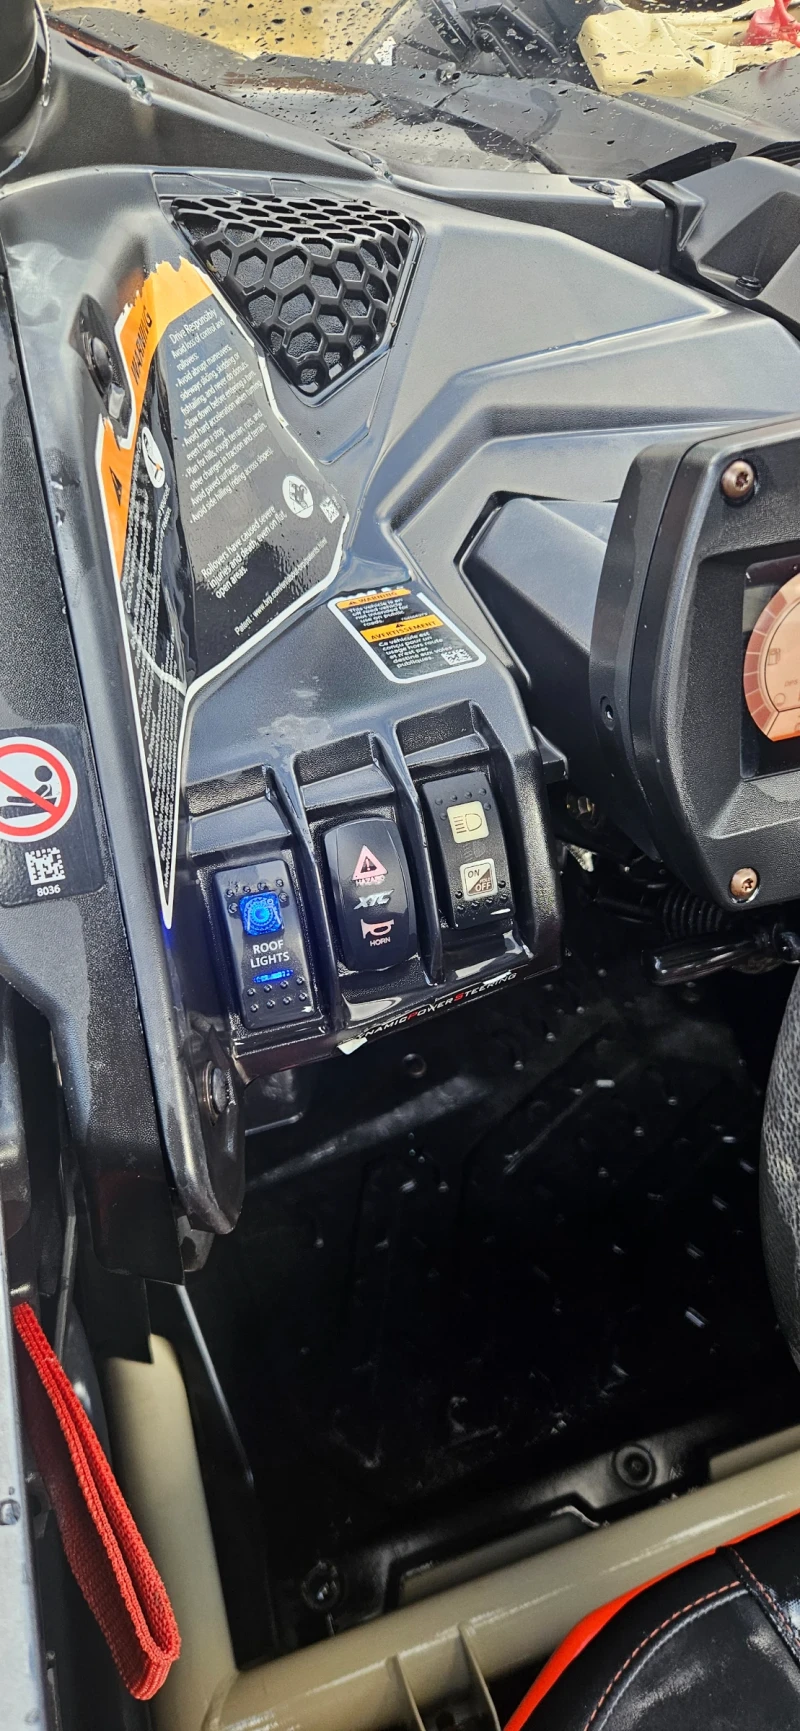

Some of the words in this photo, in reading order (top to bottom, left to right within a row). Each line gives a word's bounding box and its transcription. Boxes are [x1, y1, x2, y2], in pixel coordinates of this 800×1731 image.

[169, 329, 188, 344] Drive
[183, 308, 218, 334] Responsibly
[131, 305, 153, 386] WARNING
[171, 342, 188, 359] Avoid
[184, 338, 197, 350] loss
[195, 332, 201, 344] of
[200, 323, 216, 340] control
[214, 317, 226, 329] and
[177, 370, 193, 387] Avoid
[190, 359, 209, 377] abrupt
[180, 381, 202, 401] sideways
[200, 370, 219, 386] sliding,
[215, 355, 236, 374] skidding
[233, 352, 240, 360] or
[204, 384, 216, 398] and
[213, 377, 228, 391] never
[226, 371, 234, 381] do
[184, 415, 199, 429] Slow
[197, 405, 213, 420] down
[209, 394, 227, 409] before
[224, 381, 245, 398] entering
[183, 428, 200, 447] Avoid
[196, 420, 211, 436] hard
[208, 401, 236, 427] acceleration
[234, 392, 248, 406] when
[185, 464, 200, 477] Plan
[196, 457, 206, 468] for
[215, 437, 231, 453] rough
[243, 417, 256, 429] ruts,
[252, 408, 263, 422] and
[186, 447, 200, 461] even
[196, 438, 211, 452] from
[212, 426, 226, 440] stop.
[189, 475, 204, 492] other
[202, 459, 223, 480] changes
[220, 455, 229, 464] in
[225, 441, 245, 460] traction
[242, 431, 254, 446] and
[190, 488, 207, 507] Avoid
[204, 475, 221, 497] paved
[190, 504, 208, 522] Avoid
[205, 497, 218, 511] side
[214, 484, 232, 502] hilling
[228, 472, 247, 490] (riding
[243, 460, 259, 476] across
[200, 551, 229, 579] Rollovers
[225, 538, 243, 555] have
[240, 517, 261, 542] caused
[258, 505, 276, 525] severe
[207, 564, 232, 589] injuries
[229, 552, 243, 569] and
[240, 538, 260, 559] death,
[256, 525, 271, 542] even
[268, 518, 279, 530] on
[274, 510, 288, 523] flat,
[215, 580, 233, 599] open
[230, 565, 248, 585] areas.
[358, 592, 398, 603] WARNING
[363, 601, 388, 610] vehicle
[368, 608, 398, 618] intended
[383, 610, 405, 619] public
[234, 614, 253, 635] Patent
[371, 621, 437, 640] AVERTISSEMENT
[382, 641, 405, 652] conçu
[405, 637, 422, 648] pour
[386, 646, 408, 657] usage
[407, 642, 424, 650] hors
[424, 638, 444, 647] route
[389, 633, 419, 645] véhicule
[393, 653, 420, 664] destiné
[420, 650, 434, 658] aux
[434, 646, 453, 654] voies
[416, 646, 429, 655] pas
[396, 656, 435, 669] publiques.
[467, 868, 480, 878] ON
[36, 884, 61, 897] 8036
[475, 881, 491, 892] OFF
[353, 888, 395, 910] XTC
[252, 939, 284, 955] ROOF
[369, 937, 391, 947] HORN
[250, 951, 290, 969] LIGHTS
[357, 972, 517, 1040] NAMICPOWERSTEERING
